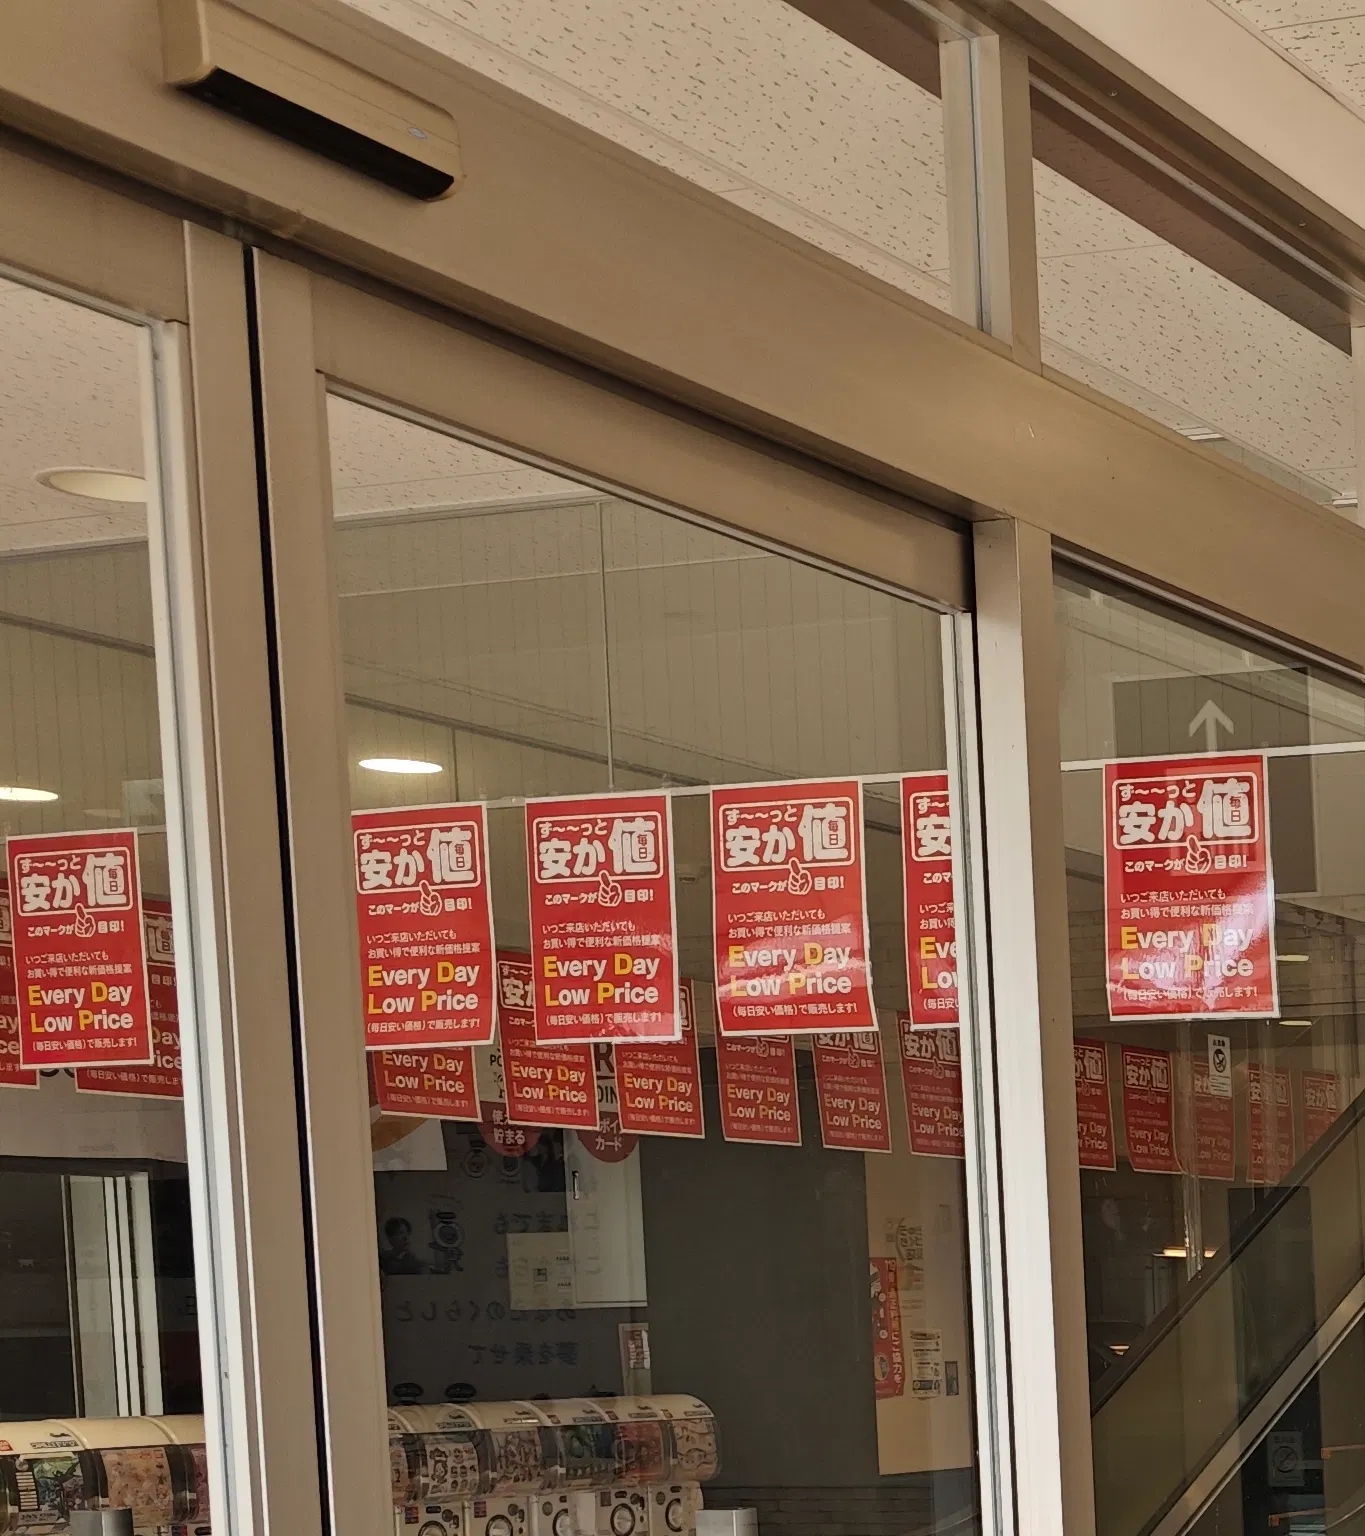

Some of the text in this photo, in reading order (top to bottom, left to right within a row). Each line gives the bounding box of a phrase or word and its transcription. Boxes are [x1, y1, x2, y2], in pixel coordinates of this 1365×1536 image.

[1121, 923, 1253, 954] Every Day
[544, 953, 660, 981] Every Day
[729, 943, 850, 971] Every Day
[1122, 955, 1253, 980] Low Price
[368, 961, 479, 989] Every Day
[730, 972, 851, 997] Low Price
[28, 982, 132, 1009] Every Day
[368, 989, 478, 1014] Low Price
[545, 982, 658, 1006] Low Price
[31, 1010, 133, 1032] Low Price
[382, 1051, 463, 1076] Every Day
[385, 1070, 465, 1094] Low Price
[511, 1064, 586, 1088] Every Day
[624, 1073, 692, 1096] Every Day
[514, 1082, 587, 1104] Low Price
[626, 1092, 693, 1112] Low Price
[727, 1084, 790, 1104] Every Day
[824, 1093, 880, 1115] Every Day
[728, 1102, 790, 1122] Low Price
[826, 1111, 882, 1131] Low Price
[494, 1126, 525, 1145] 貯まる
[595, 1135, 622, 1152] カード
